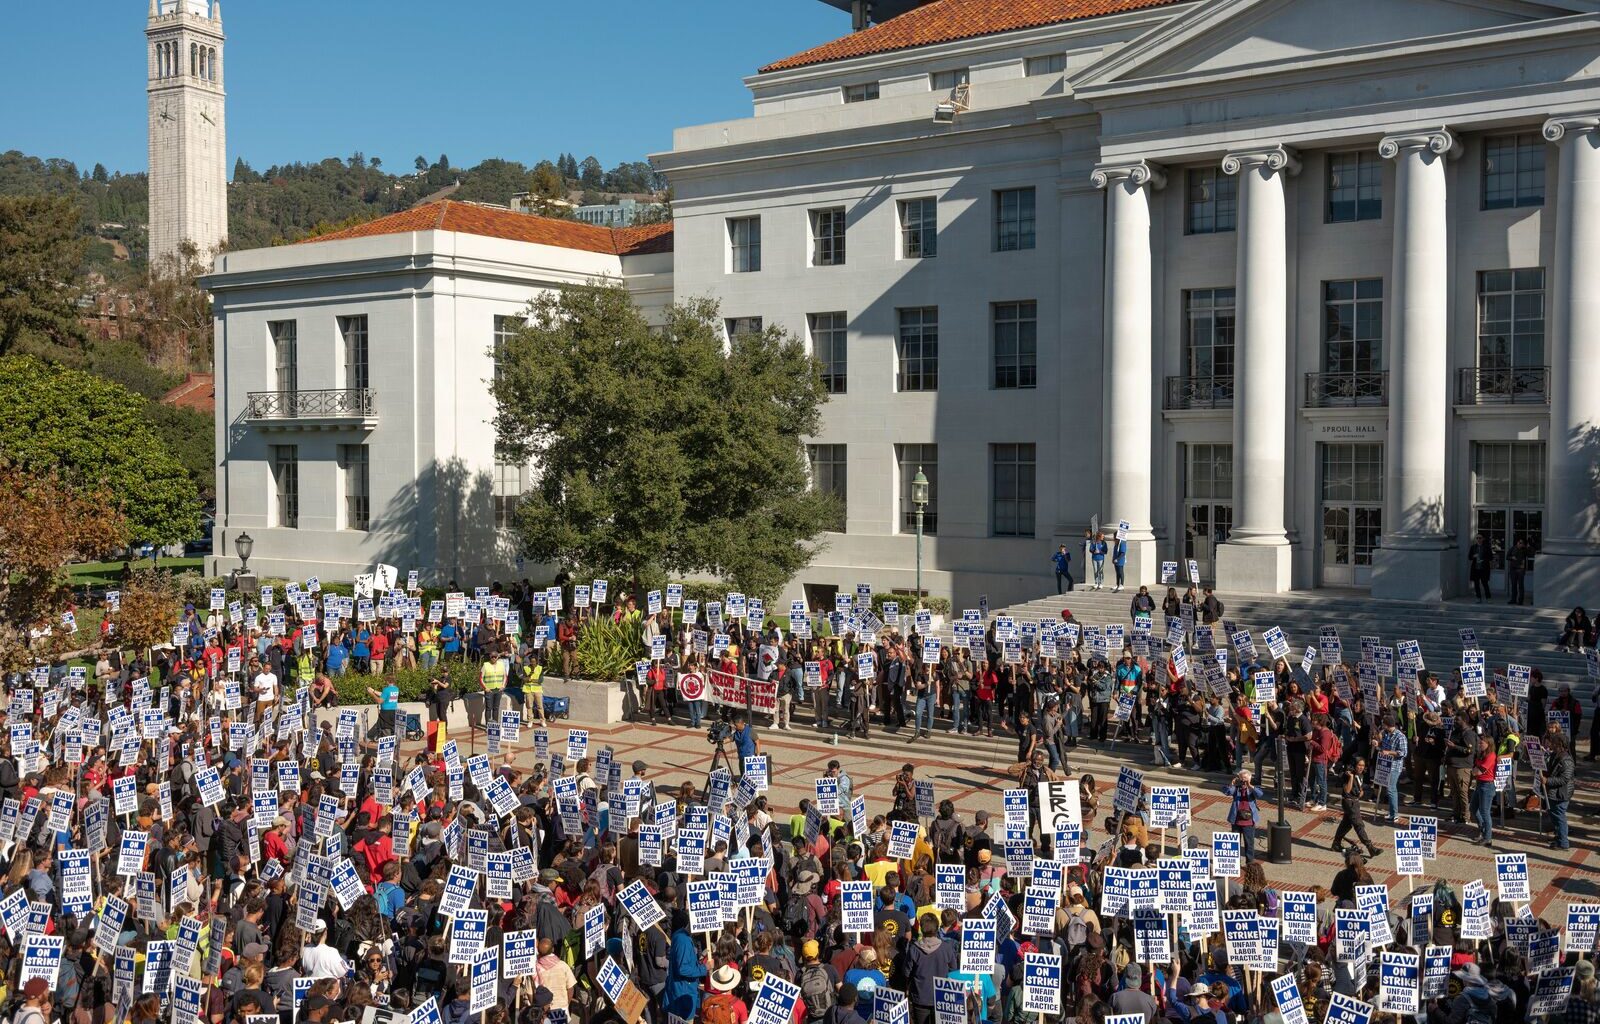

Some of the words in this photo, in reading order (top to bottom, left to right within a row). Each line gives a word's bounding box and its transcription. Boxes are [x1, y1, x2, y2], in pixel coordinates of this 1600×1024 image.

[1264, 627, 1279, 638] UAW
[724, 689, 775, 708] DISGSTING
[196, 768, 215, 780] UAW
[115, 777, 134, 786] UAW
[204, 776, 213, 784] ON
[484, 777, 504, 792] UAW
[494, 786, 503, 795] ON
[56, 791, 74, 801] UAW
[492, 788, 511, 803] STRIKE
[497, 795, 512, 806] UNFAIR
[500, 799, 514, 810] LABOR
[499, 801, 519, 815] PRACTICE
[124, 832, 147, 840] UAW
[122, 848, 143, 856] STRIKE
[1215, 849, 1238, 857] STRIKE
[488, 854, 511, 862] UAW
[1159, 861, 1190, 869] UAW
[488, 870, 511, 878] STRIKE
[937, 866, 964, 874] UAW
[1169, 872, 1181, 880] ON
[1500, 872, 1526, 880] STRIKE
[688, 882, 718, 892] UAW
[843, 883, 871, 891] UAW
[938, 883, 963, 891] STRIKE
[1161, 880, 1190, 889] STRIKE
[618, 882, 641, 900] UAW
[631, 893, 641, 903] ON
[698, 893, 710, 901] ON
[852, 893, 863, 901] ON
[1284, 894, 1314, 902] UAW
[629, 895, 652, 913] STRIKE
[691, 900, 719, 910] STRIKE
[844, 901, 871, 909] STRIKE
[1293, 904, 1305, 912] ON
[636, 904, 654, 917] UNFAIR
[640, 909, 657, 921] LABOR
[456, 911, 486, 920] UAW
[640, 911, 664, 928] PRACTICE
[1224, 911, 1256, 920] UAW
[1285, 912, 1314, 921] STRIKE
[464, 922, 476, 930] ON
[693, 922, 722, 930] PRACTICE
[965, 921, 995, 929] UAW
[1235, 922, 1248, 930] ON
[454, 930, 484, 939] STRIKE
[507, 931, 534, 941] UAW
[973, 932, 985, 940] ON
[1228, 931, 1258, 939] STRIKE
[1285, 935, 1315, 943] PRACTICE
[515, 941, 526, 949] ON
[964, 941, 993, 949] STRIKE
[474, 948, 498, 964] UAW
[507, 947, 534, 957] STRIKE
[451, 954, 471, 962] PRACT
[509, 957, 531, 965] UNFAIR
[1027, 955, 1060, 966] UAW
[1383, 954, 1417, 966] UAW
[481, 962, 490, 973] ON
[1036, 967, 1049, 976] ON
[1393, 967, 1406, 976] ON
[505, 968, 534, 977] PRACTICE
[473, 970, 496, 986] STRIKE
[1027, 976, 1058, 987] STRIKE
[1383, 975, 1416, 987] STRIKE
[476, 982, 494, 994] UNFAIR
[1030, 987, 1055, 996] UNFAIR
[1386, 987, 1413, 996] UNFAIR
[476, 990, 492, 1002] LABOR
[1031, 995, 1053, 1003] LABOR
[1388, 995, 1411, 1004] LABOR
[472, 996, 496, 1011] PRACTICE
[1025, 1001, 1058, 1011] PRACTICE
[1382, 1002, 1416, 1012] PRACTICE
